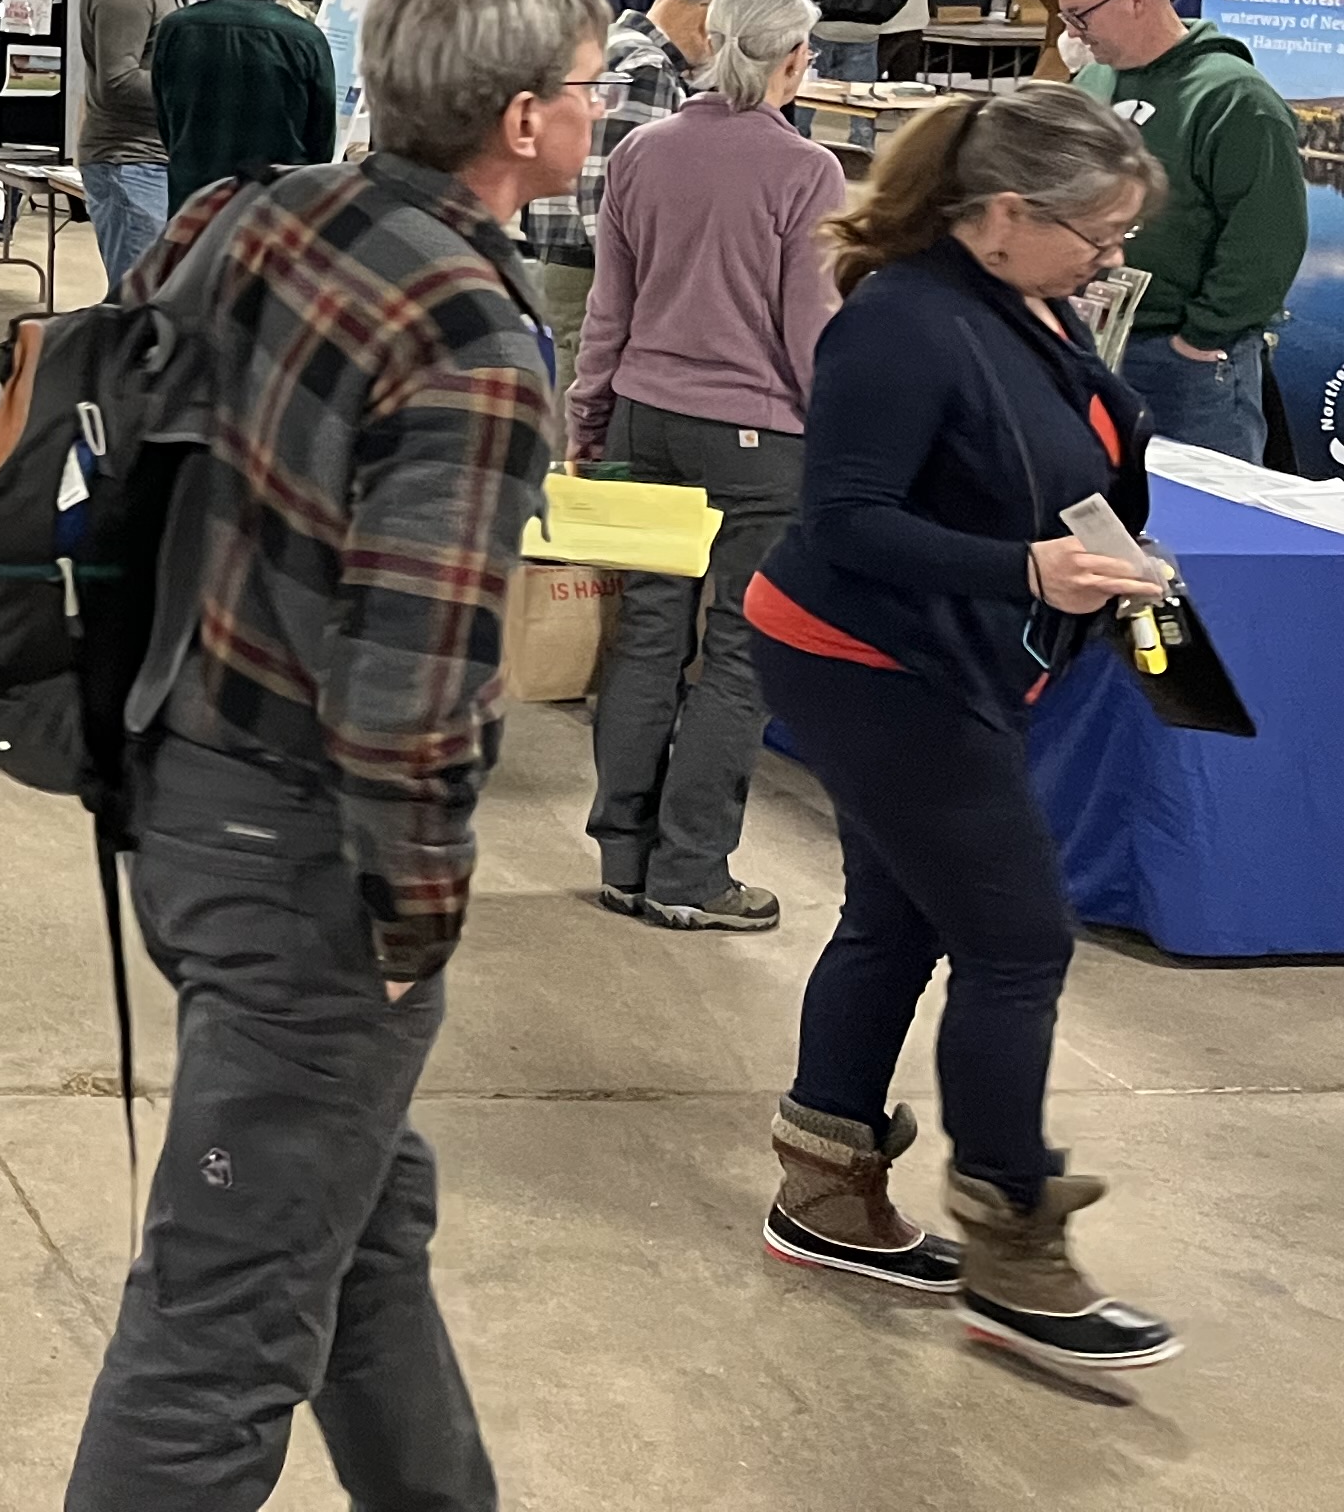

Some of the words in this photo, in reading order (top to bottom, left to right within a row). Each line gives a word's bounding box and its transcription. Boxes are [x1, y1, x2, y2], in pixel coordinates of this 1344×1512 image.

[1221, 11, 1296, 31] waterways
[1300, 14, 1318, 29] of
[1253, 35, 1333, 55] Hampshire
[550, 582, 569, 601] IS
